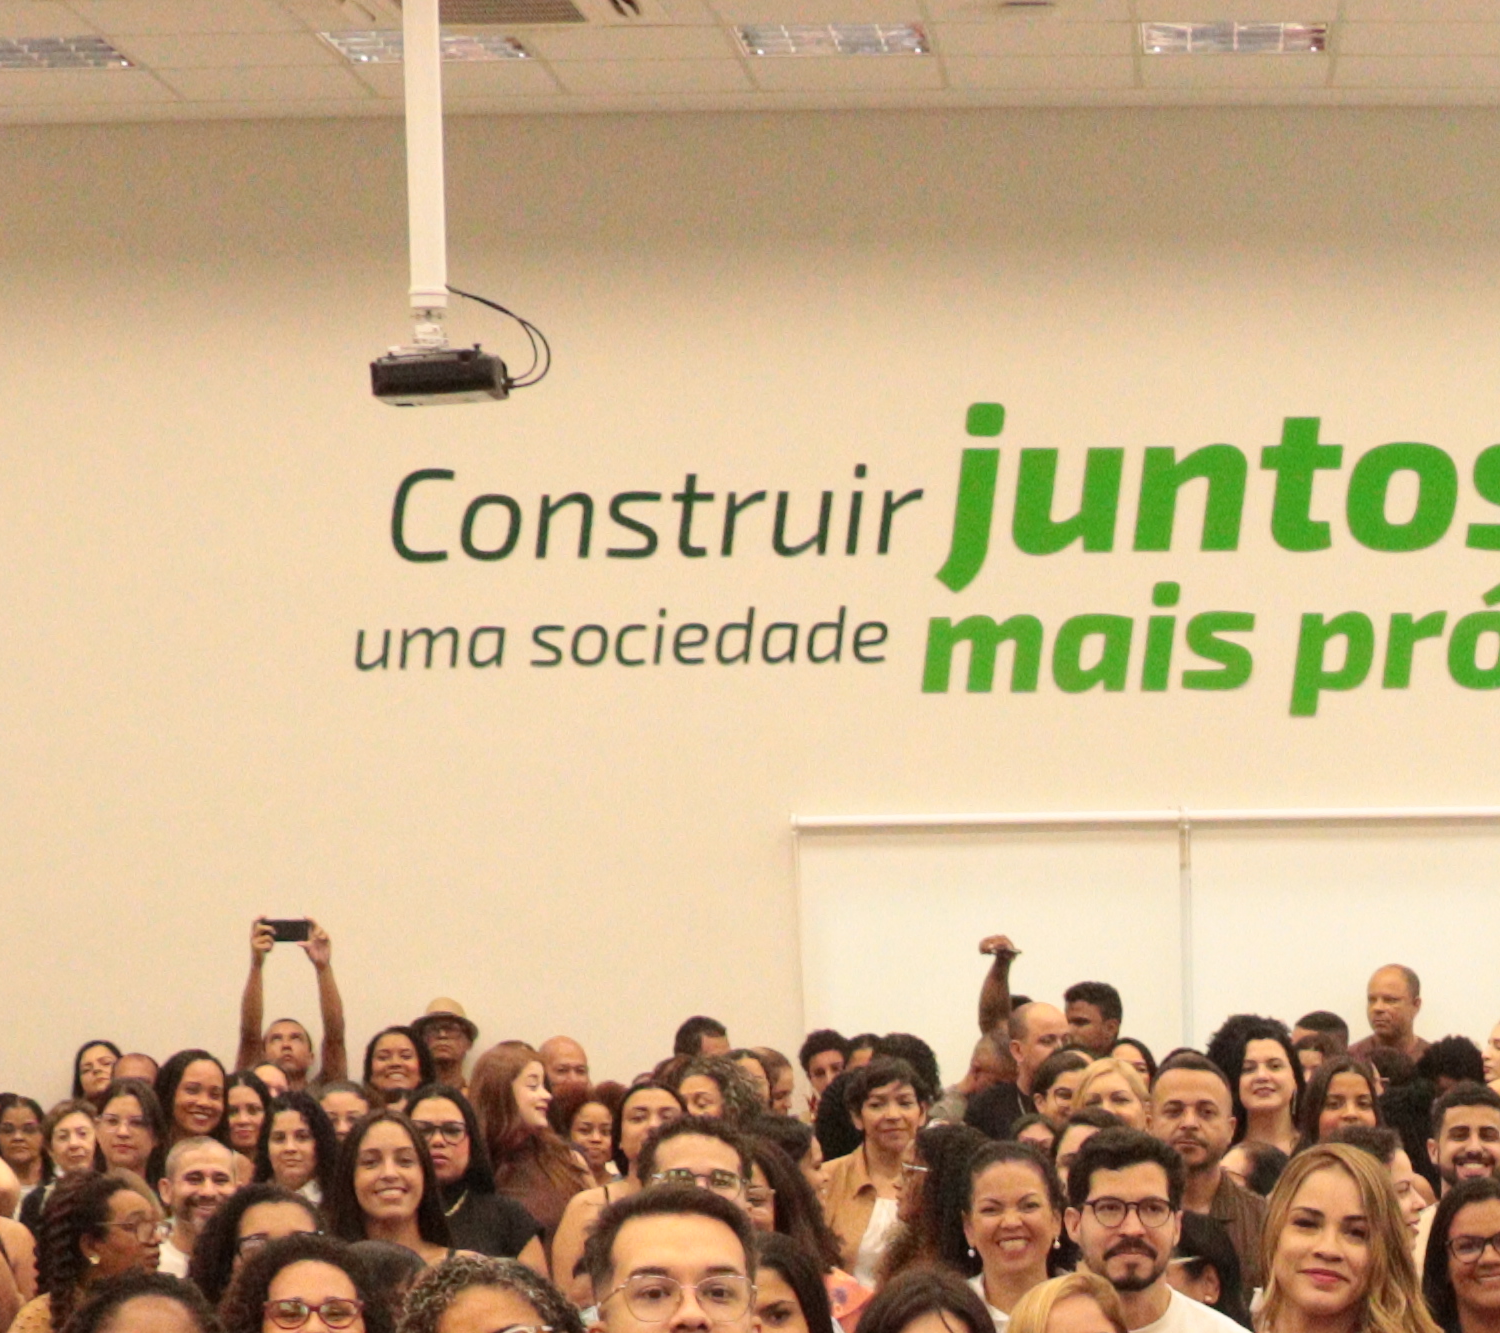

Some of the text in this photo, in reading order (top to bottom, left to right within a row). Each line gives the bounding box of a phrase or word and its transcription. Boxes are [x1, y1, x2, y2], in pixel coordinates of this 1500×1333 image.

[391, 463, 925, 564] Construir
[355, 625, 507, 672] uma
[531, 605, 890, 668] sociedade
[922, 581, 1256, 694] mais
